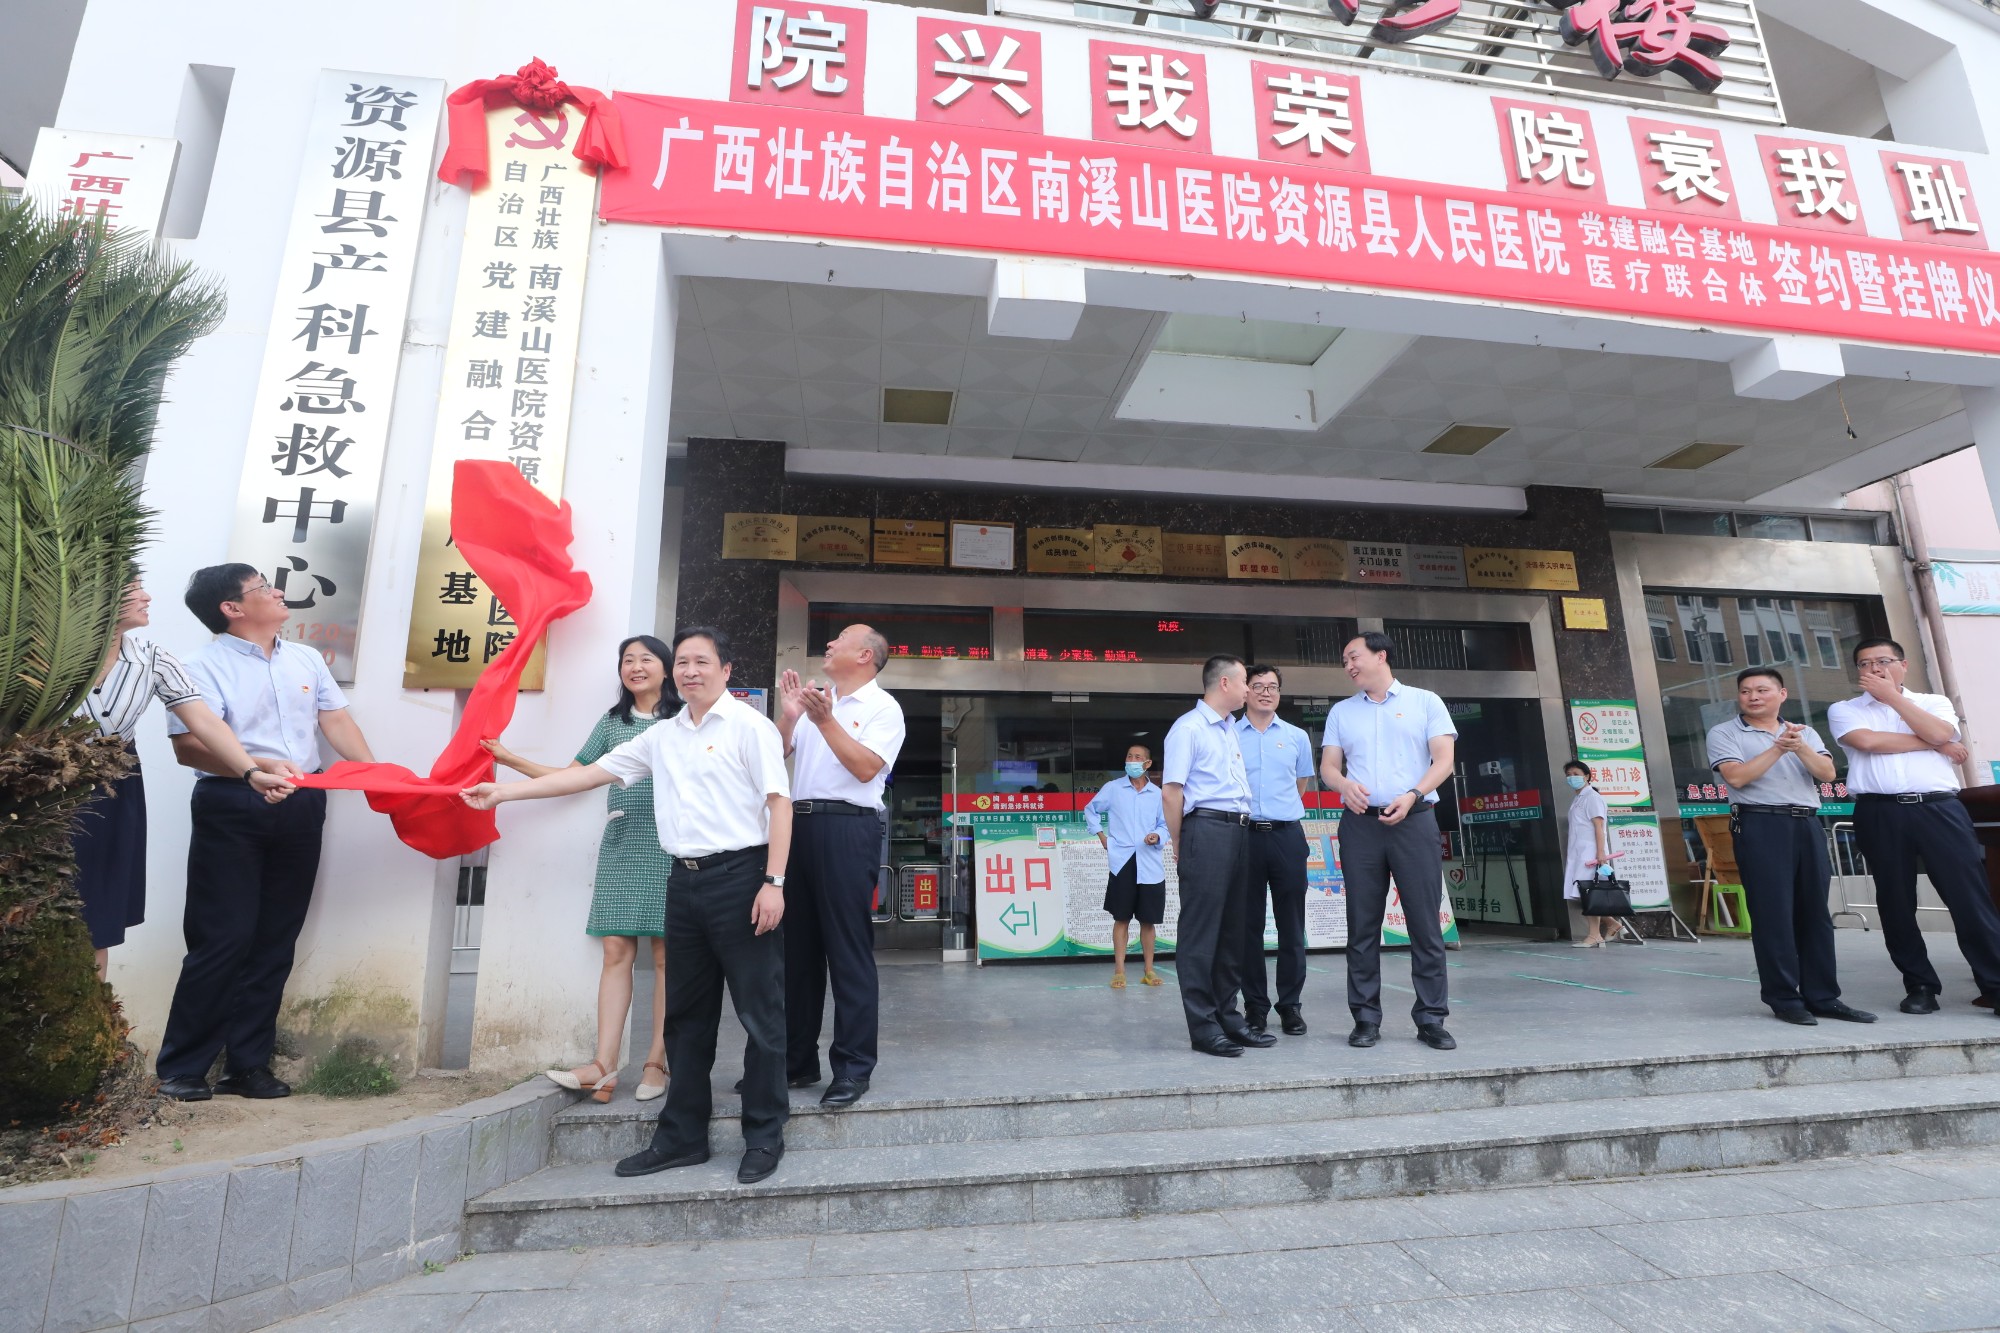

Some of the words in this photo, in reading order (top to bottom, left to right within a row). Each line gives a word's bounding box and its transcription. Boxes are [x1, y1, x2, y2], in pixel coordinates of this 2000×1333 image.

[747, 6, 1357, 160] 院兴我荣
[652, 116, 1570, 276] 广西壮族自治区南溪山医院资源县人民医院
[1508, 106, 1980, 234] 院衰我耻
[494, 160, 526, 249] 自治区
[531, 163, 567, 250] 广西壮族
[1578, 210, 1757, 267] 党建融合基地
[1586, 254, 1767, 307] 医疗联合体
[1767, 238, 2000, 325] 签约暨挂牌仪
[261, 83, 419, 609] 资源县产科急救中心
[1045, 548, 1078, 557] 成员单位
[1240, 564, 1279, 574] 联盟单位
[1359, 557, 1399, 567] 天门山景区
[1590, 767, 1641, 782] 发热门诊
[920, 879, 932, 905] 出口
[985, 853, 1052, 895] 出口
